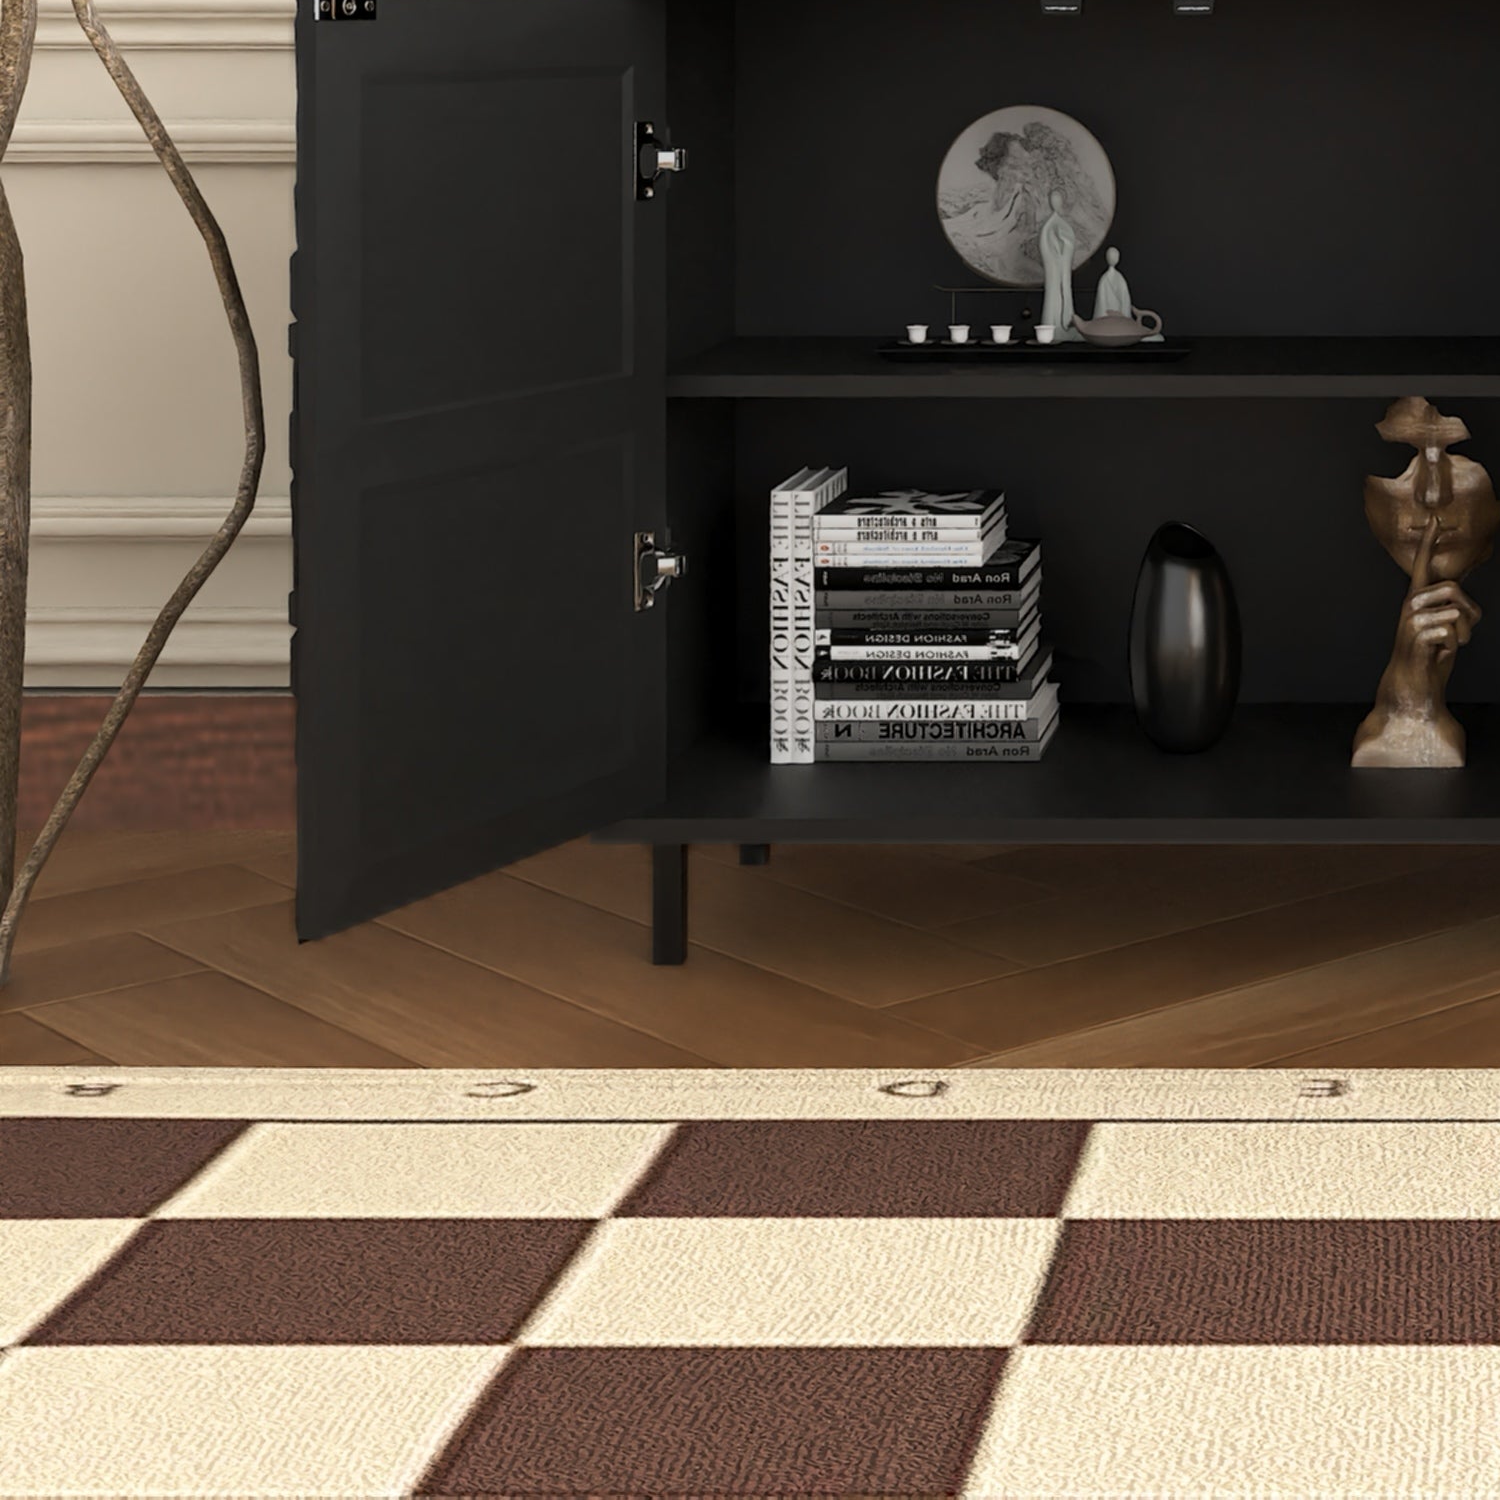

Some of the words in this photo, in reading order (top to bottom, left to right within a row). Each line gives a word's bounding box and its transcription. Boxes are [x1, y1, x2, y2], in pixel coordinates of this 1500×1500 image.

[464, 1079, 539, 1098] C
[878, 1079, 950, 1098] D
[1301, 1079, 1350, 1098] E
